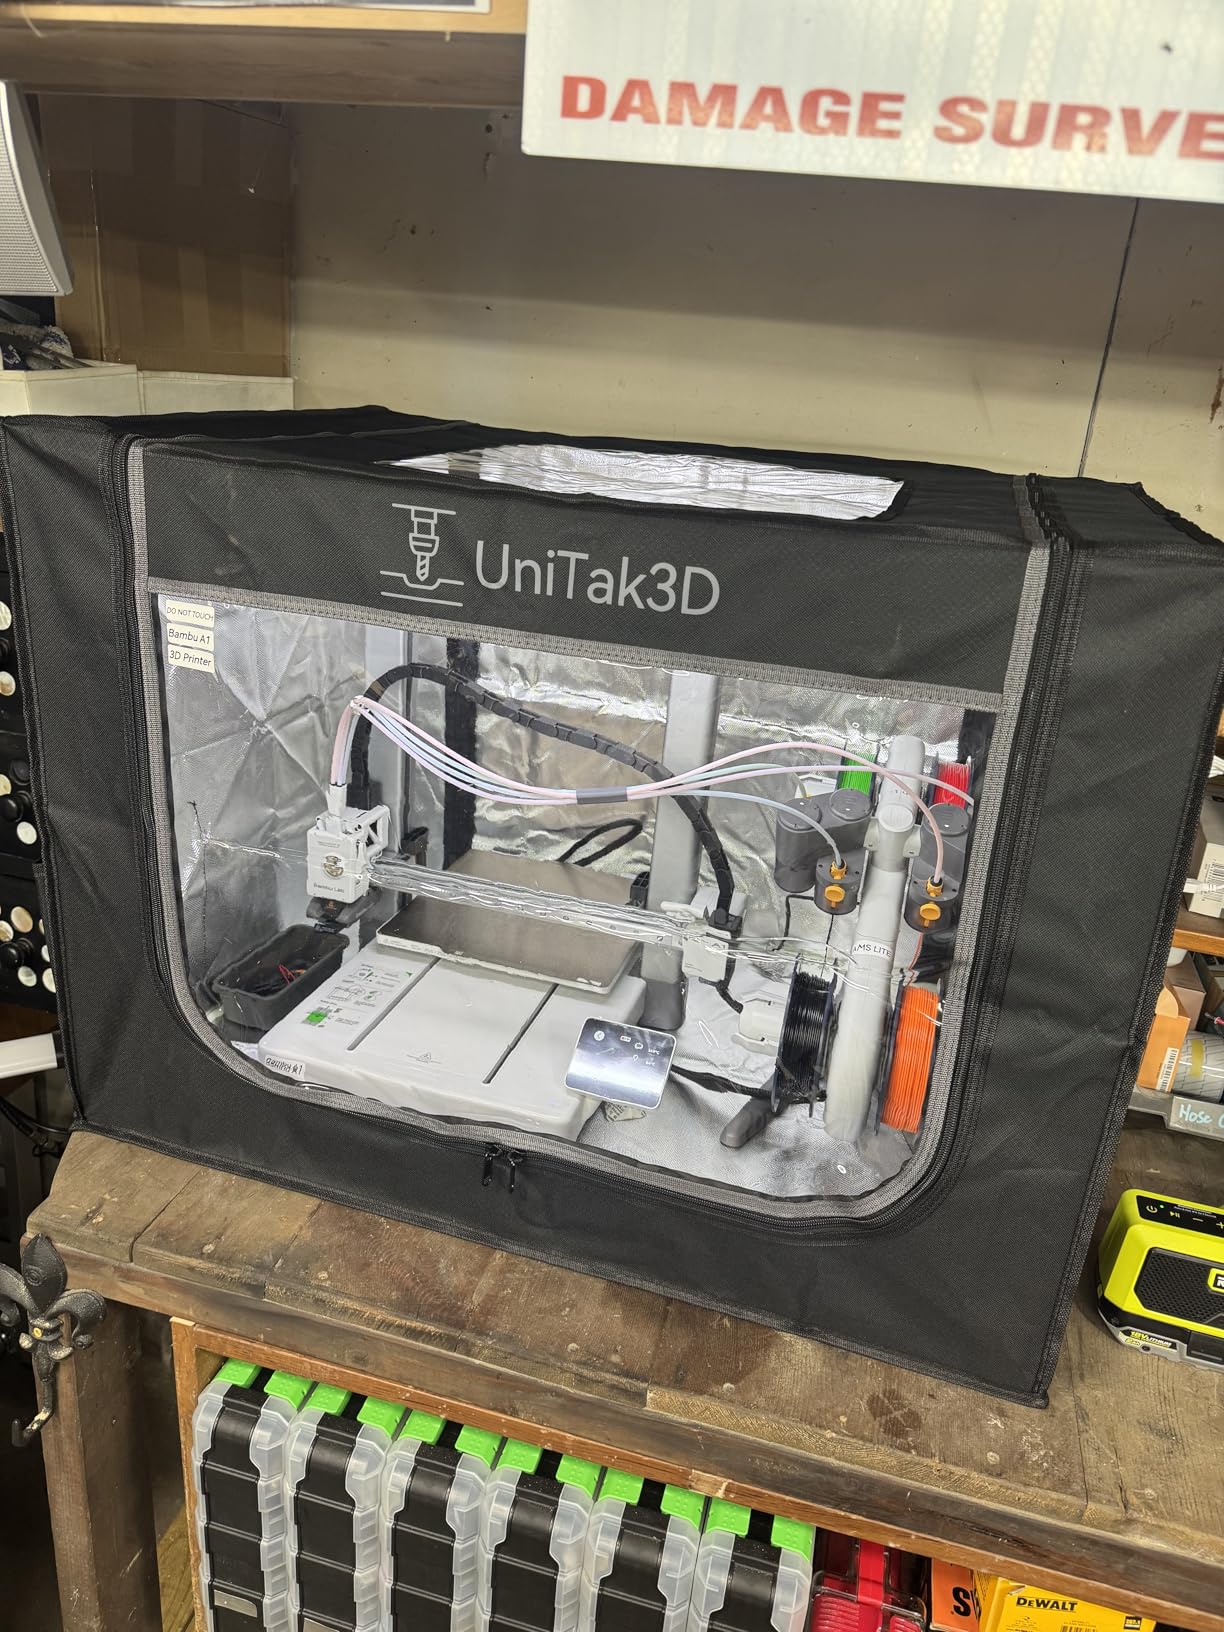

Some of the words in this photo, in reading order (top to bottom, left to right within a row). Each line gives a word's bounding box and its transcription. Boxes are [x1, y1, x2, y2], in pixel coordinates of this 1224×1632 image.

[559, 75, 906, 139] DAMAGE
[933, 96, 1224, 162] SURVE
[475, 540, 721, 616] UniTak3D
[166, 606, 177, 615] DO
[178, 608, 191, 616] NOT
[192, 611, 214, 621] TOUCH
[168, 628, 199, 642] Bambu
[200, 635, 210, 645] A1
[169, 650, 182, 660] 3D
[183, 653, 212, 667] Printer
[873, 945, 892, 958] LITE
[1179, 1103, 1213, 1124] Hose
